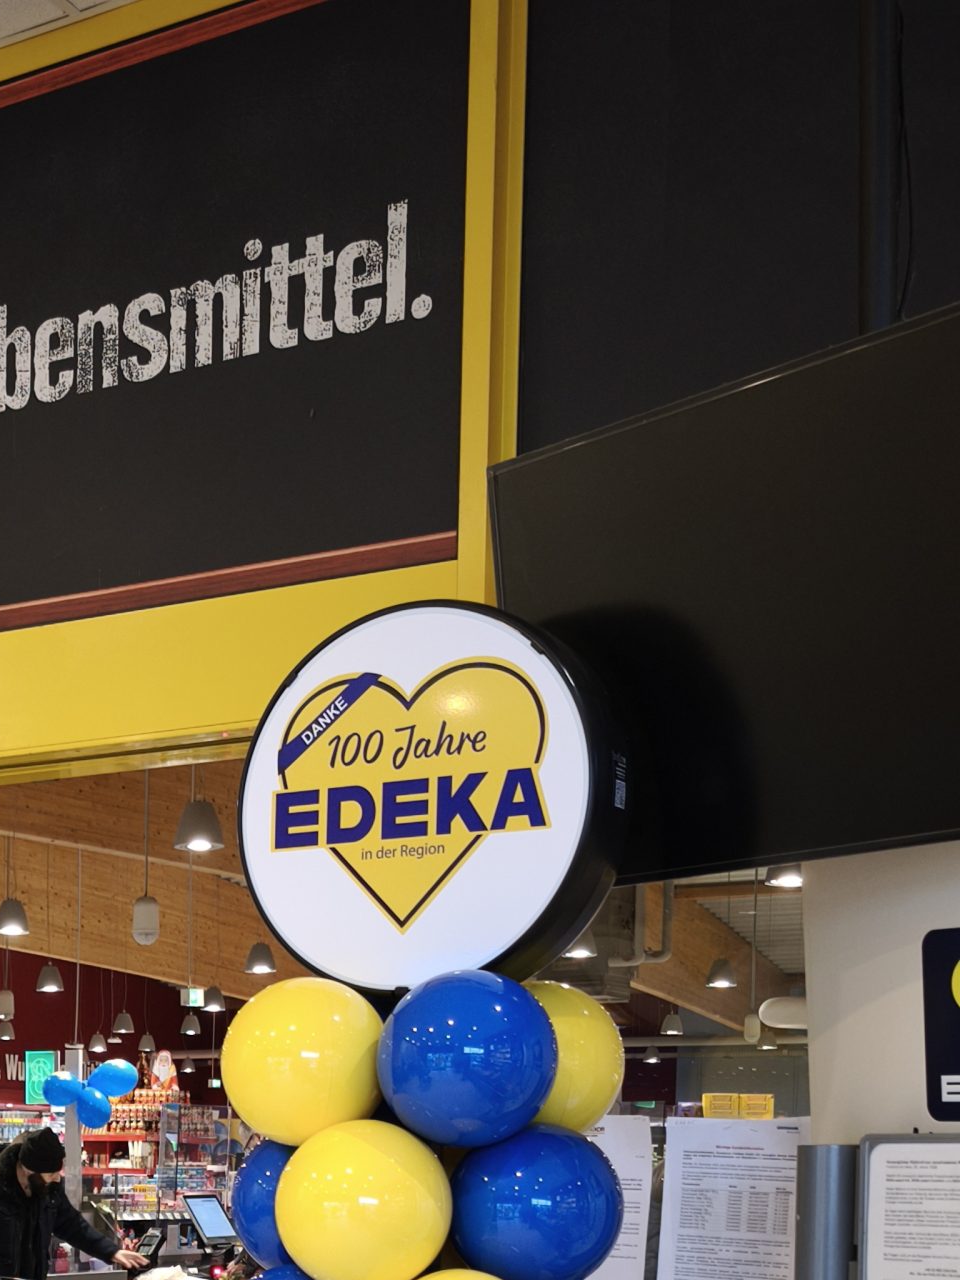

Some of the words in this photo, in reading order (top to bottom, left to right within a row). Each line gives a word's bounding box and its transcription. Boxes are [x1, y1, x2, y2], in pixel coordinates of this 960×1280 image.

[301, 696, 348, 746] DANKE
[328, 729, 384, 769] 100
[392, 720, 488, 770] Jahre
[274, 767, 547, 850] EDEKA
[361, 848, 373, 861] in
[375, 844, 397, 860] der
[400, 842, 445, 860] Region
